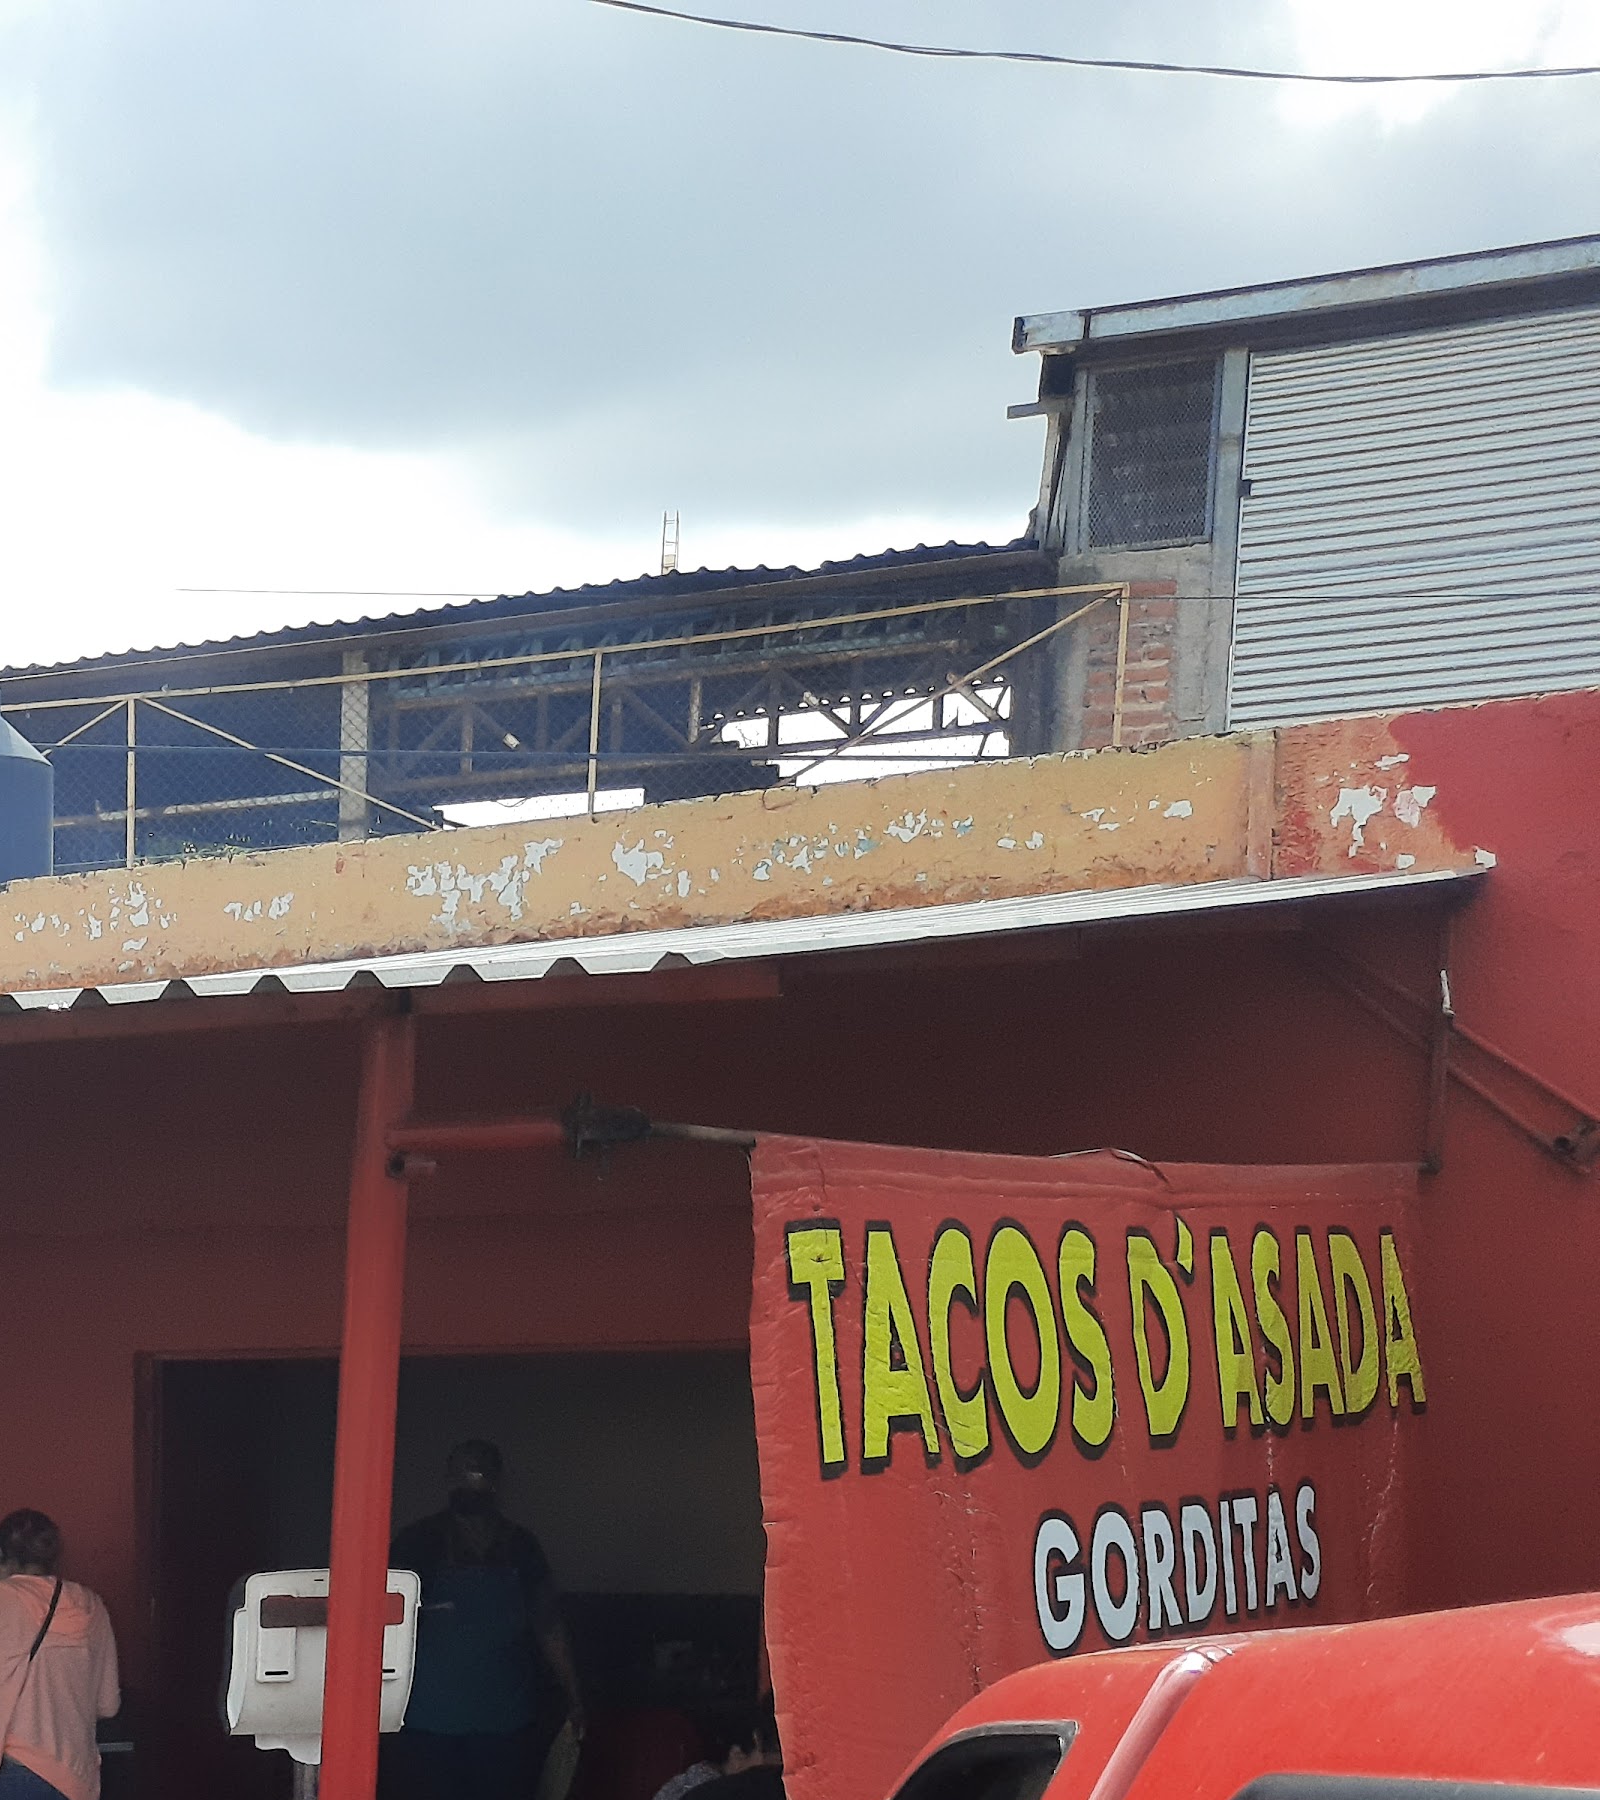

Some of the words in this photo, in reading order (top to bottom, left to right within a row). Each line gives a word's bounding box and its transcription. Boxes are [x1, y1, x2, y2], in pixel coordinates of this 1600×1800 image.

[787, 1221, 1116, 1472] TACOS
[1126, 1215, 1426, 1438] D'ASADA
[1033, 1485, 1322, 1651] GORDITAS
